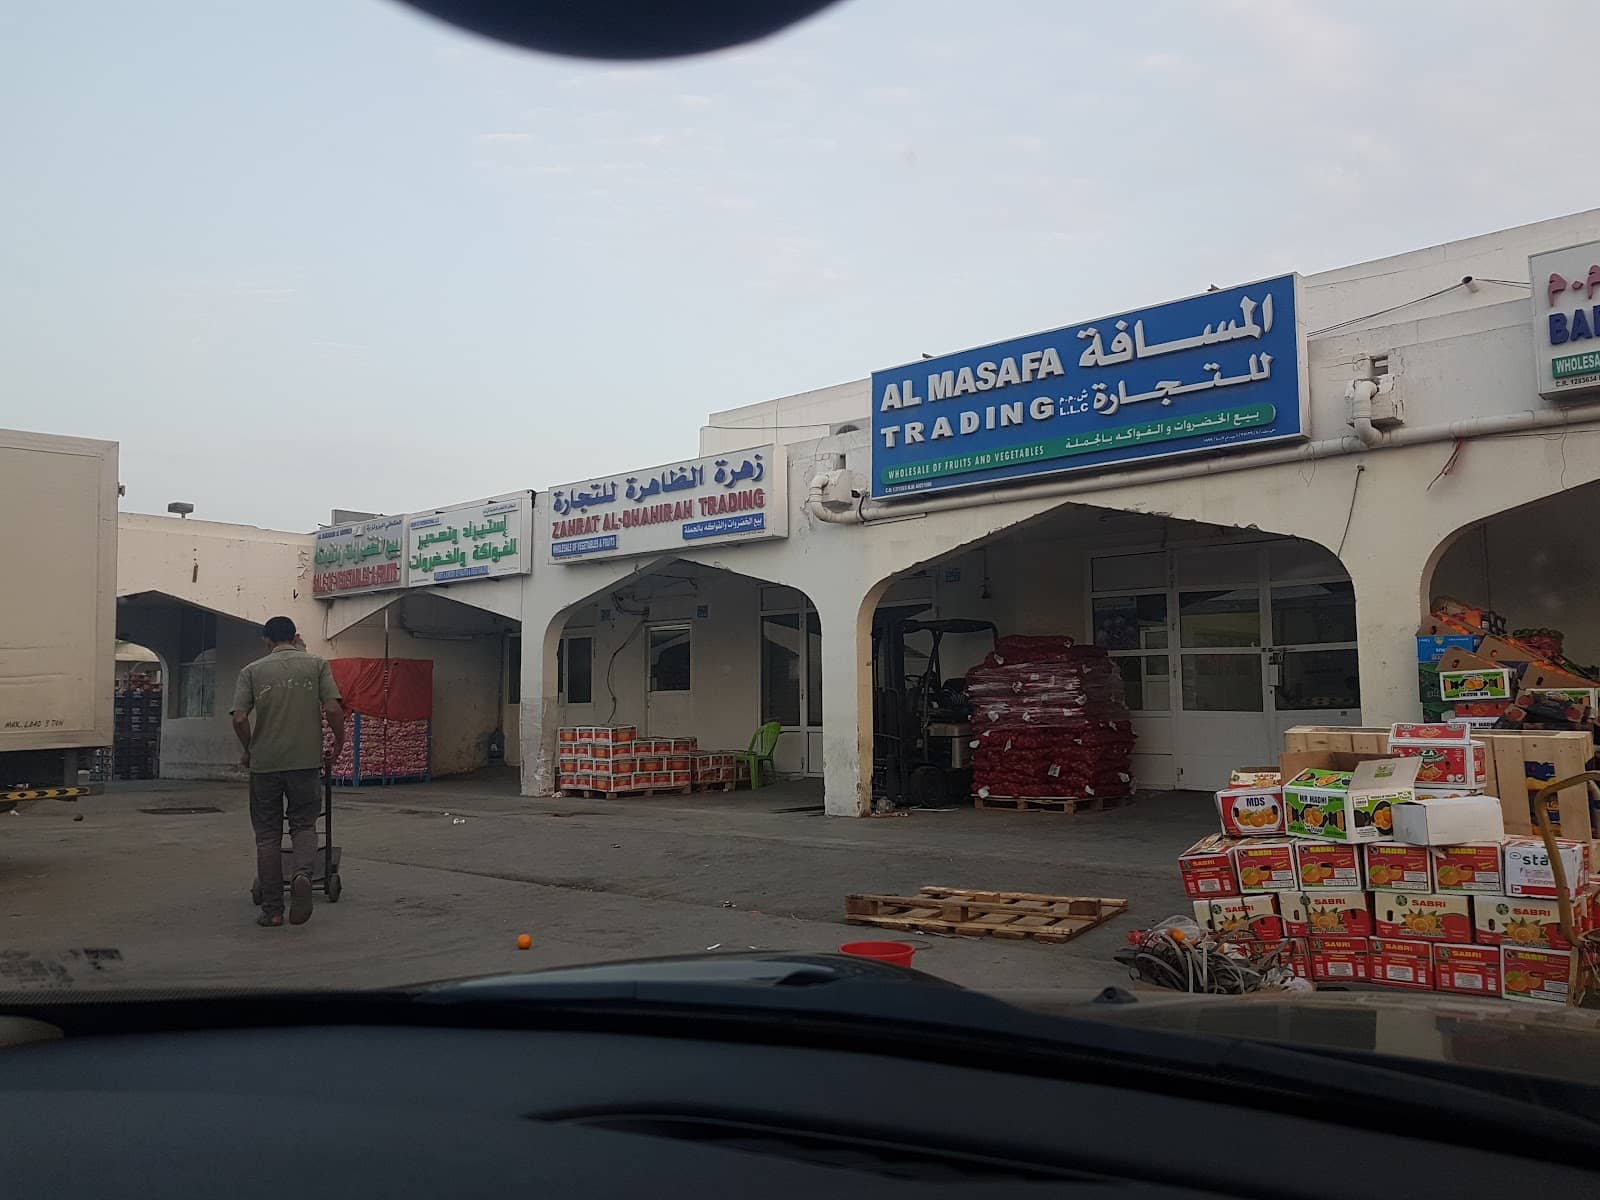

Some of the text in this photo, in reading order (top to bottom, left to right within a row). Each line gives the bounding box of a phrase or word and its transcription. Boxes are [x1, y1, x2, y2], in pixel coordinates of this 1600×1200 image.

[1078, 292, 1274, 368] المسافة
[880, 347, 1065, 412] AL MASAFA
[1092, 351, 1275, 415] للتجارة
[881, 396, 1055, 448] TRADING
[1173, 411, 1230, 432] الخضروات
[1233, 409, 1260, 426] بيع
[1064, 433, 1113, 449] بالجملة
[1115, 425, 1163, 441] الفواكه
[714, 453, 765, 488] زهرة
[888, 445, 1045, 480] WHOLESALE OF FRUITS AND VEGETABLES
[624, 463, 705, 503] الظاهرة
[552, 480, 618, 516] للتجارة
[551, 514, 601, 540] ZAHRAT
[698, 487, 766, 517] TRADING
[1246, 797, 1266, 807] MDS
[1192, 859, 1216, 867] SABRI
[1224, 904, 1255, 913] SABRI
[1314, 898, 1346, 906] SABRI
[1411, 899, 1446, 908] SABRI
[1512, 907, 1551, 917] SABRI
[1324, 940, 1351, 948] SABRI
[1385, 943, 1413, 952] SABRI
[1452, 949, 1482, 959] SABRI
